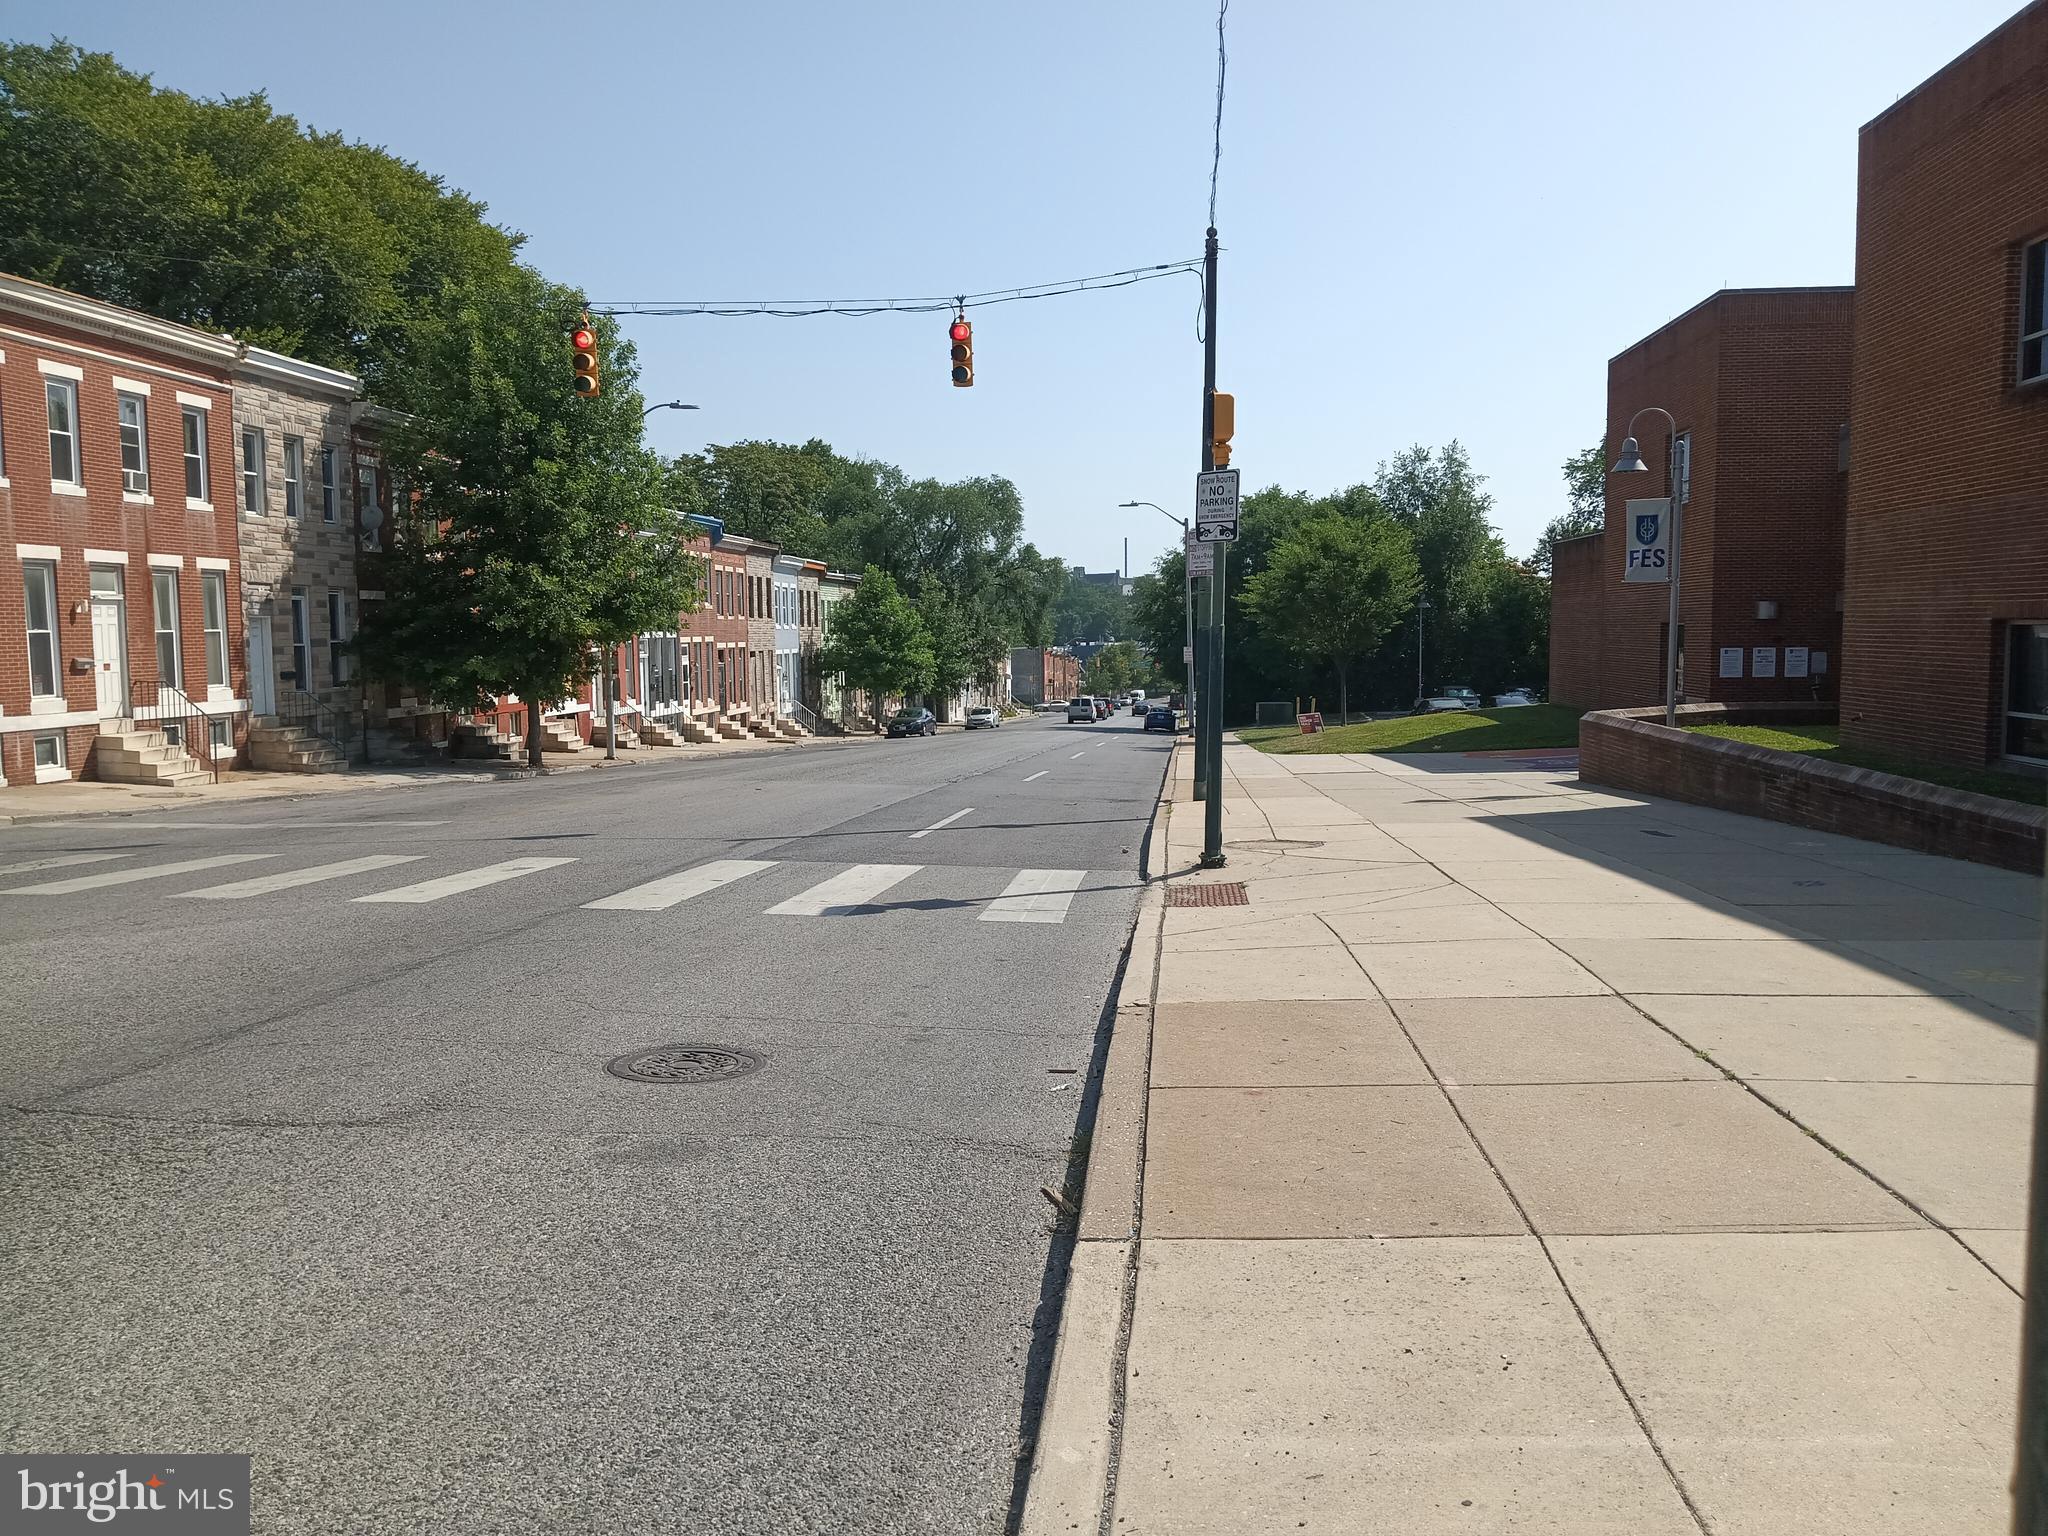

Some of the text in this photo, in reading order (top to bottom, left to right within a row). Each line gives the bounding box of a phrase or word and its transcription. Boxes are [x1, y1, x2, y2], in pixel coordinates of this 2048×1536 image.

[1209, 485, 1224, 496] NO
[1200, 497, 1233, 507] PARKING
[1629, 548, 1665, 568] FES
